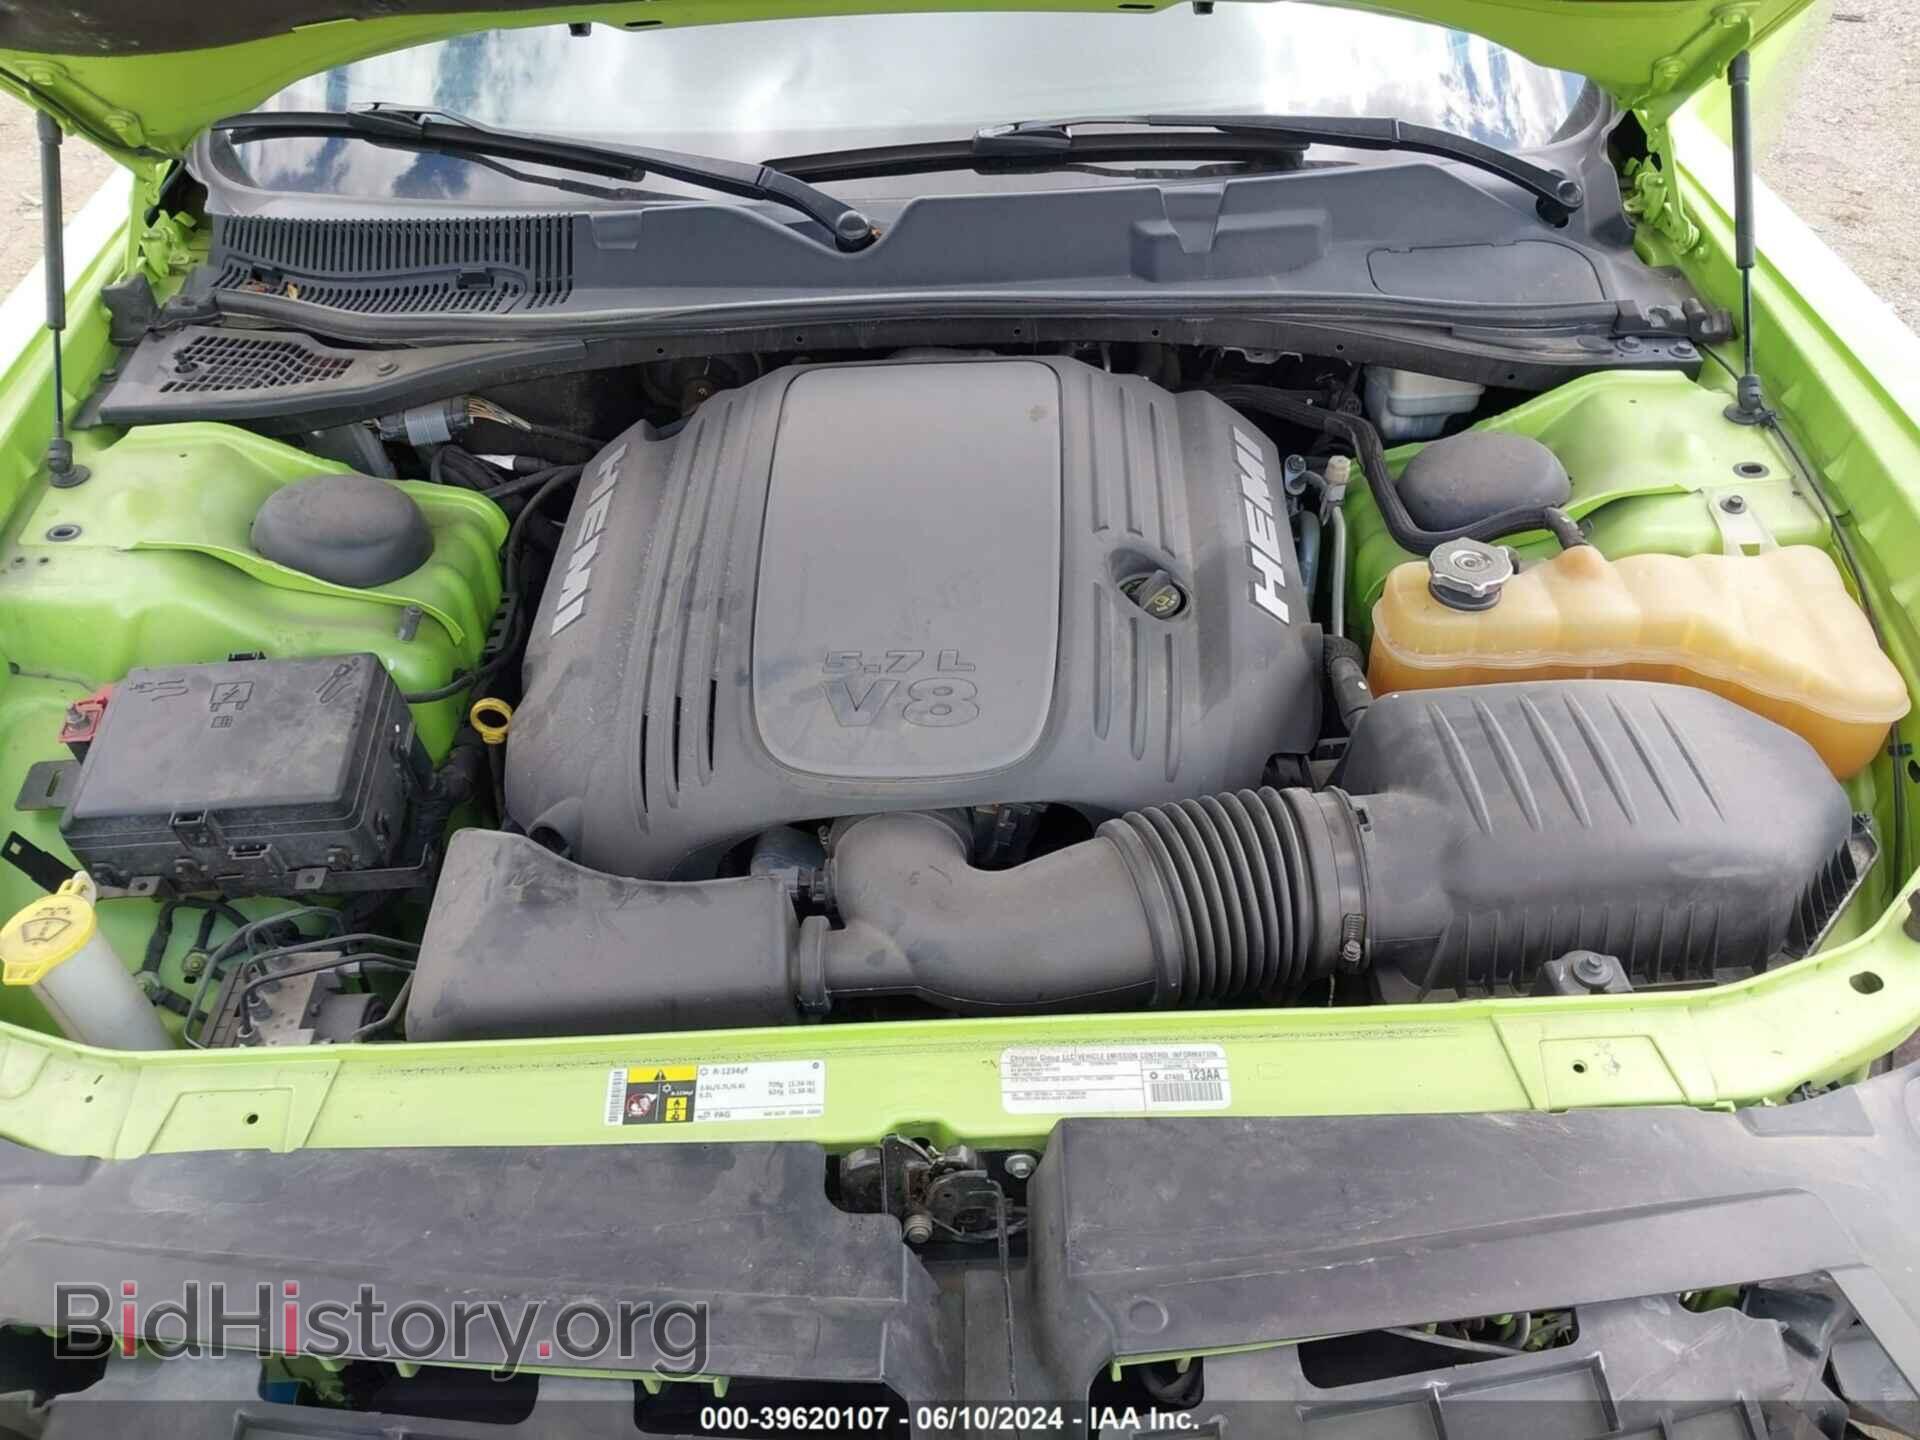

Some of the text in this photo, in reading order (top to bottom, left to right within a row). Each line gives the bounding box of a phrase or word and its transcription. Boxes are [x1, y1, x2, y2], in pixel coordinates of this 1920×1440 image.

[550, 443, 628, 637] HEMI
[1233, 426, 1290, 624] HEMI
[820, 677, 980, 727] V8
[1106, 1052, 1138, 1061] EMISSION
[1173, 1050, 1218, 1058] INFORMATION
[1189, 1068, 1220, 1081] 123AA
